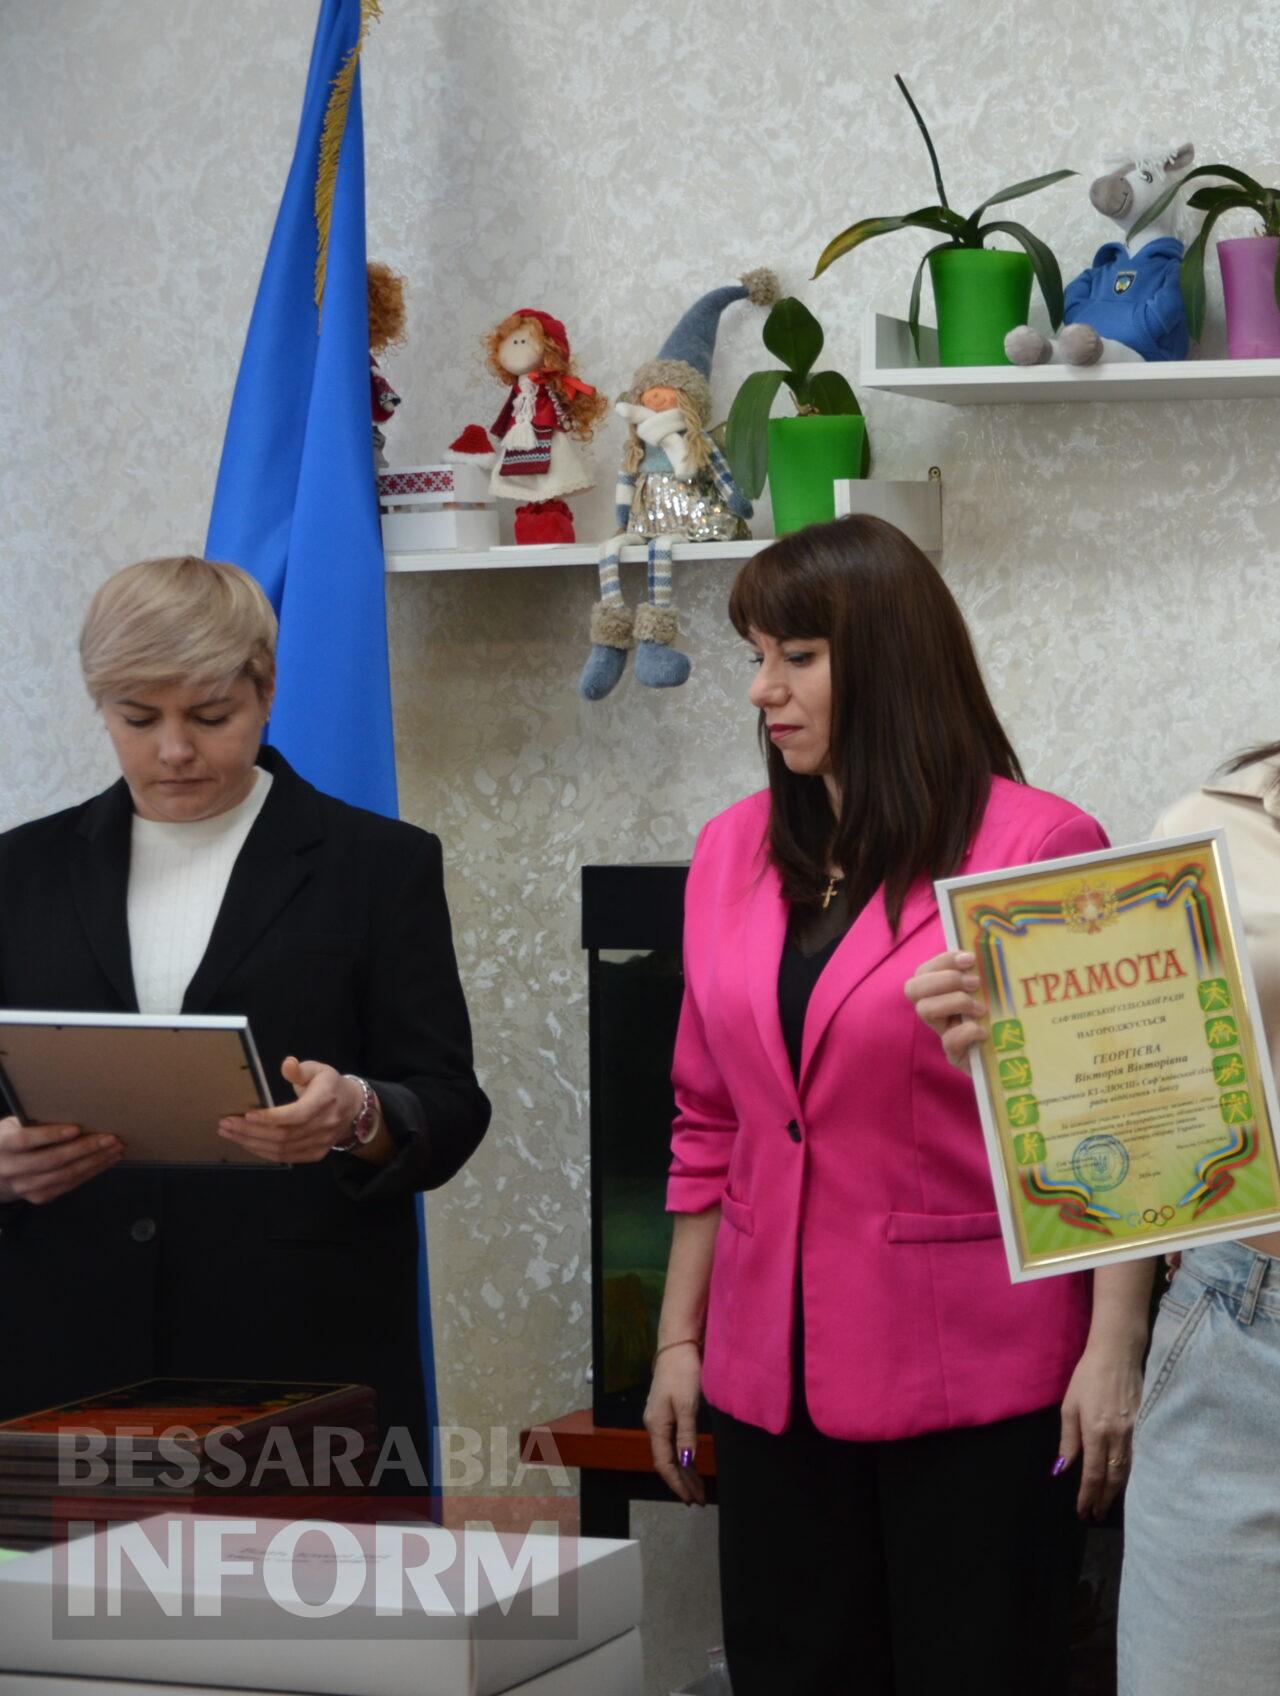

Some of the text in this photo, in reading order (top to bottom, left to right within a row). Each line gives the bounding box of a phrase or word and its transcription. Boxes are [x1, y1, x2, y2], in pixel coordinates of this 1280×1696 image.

[1019, 949, 1188, 1009] ГРАМОТА
[1076, 1015, 1168, 1040] НАГОРОДЖУЄТЬСЯ
[1093, 1043, 1162, 1065] ГЕОРГІЄВА
[1074, 1066, 1125, 1084] Вікторія
[1127, 1054, 1189, 1074] Вікторівна
